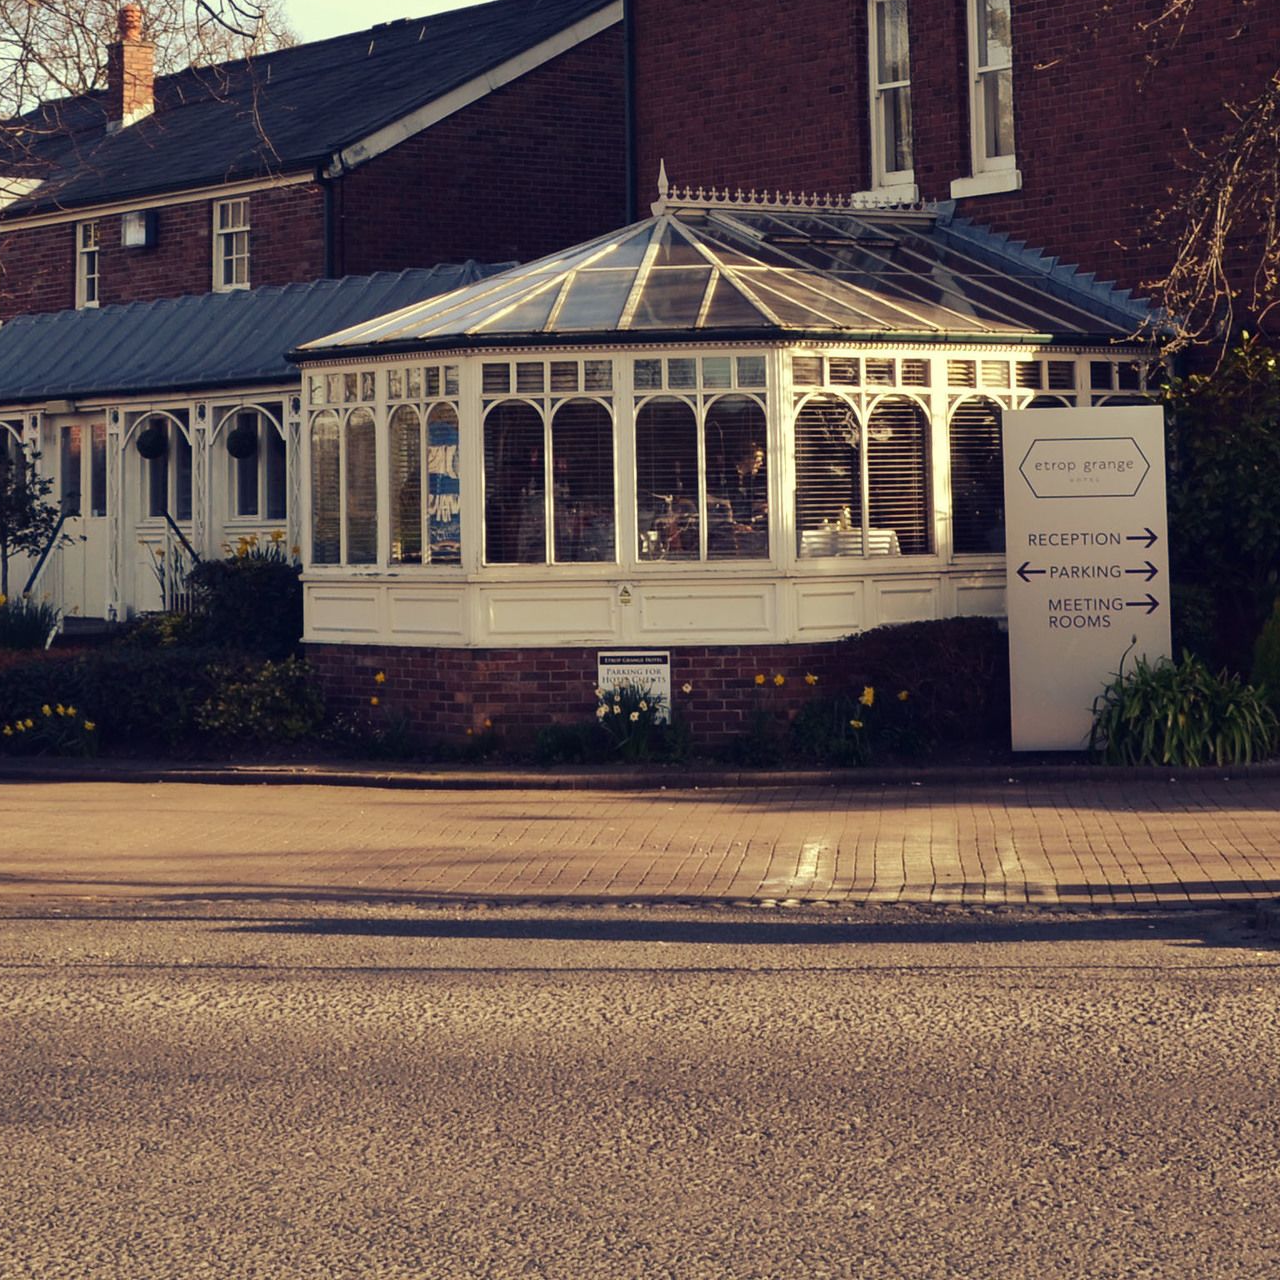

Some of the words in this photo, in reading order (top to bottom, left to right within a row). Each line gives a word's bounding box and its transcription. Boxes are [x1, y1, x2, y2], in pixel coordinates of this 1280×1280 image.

[1035, 461, 1076, 472] etrop
[1083, 460, 1134, 473] grange
[1028, 532, 1121, 546] RECEPTION
[1050, 565, 1121, 578] PARKING
[1048, 598, 1123, 611] MEETING
[1049, 615, 1111, 628] ROOMS
